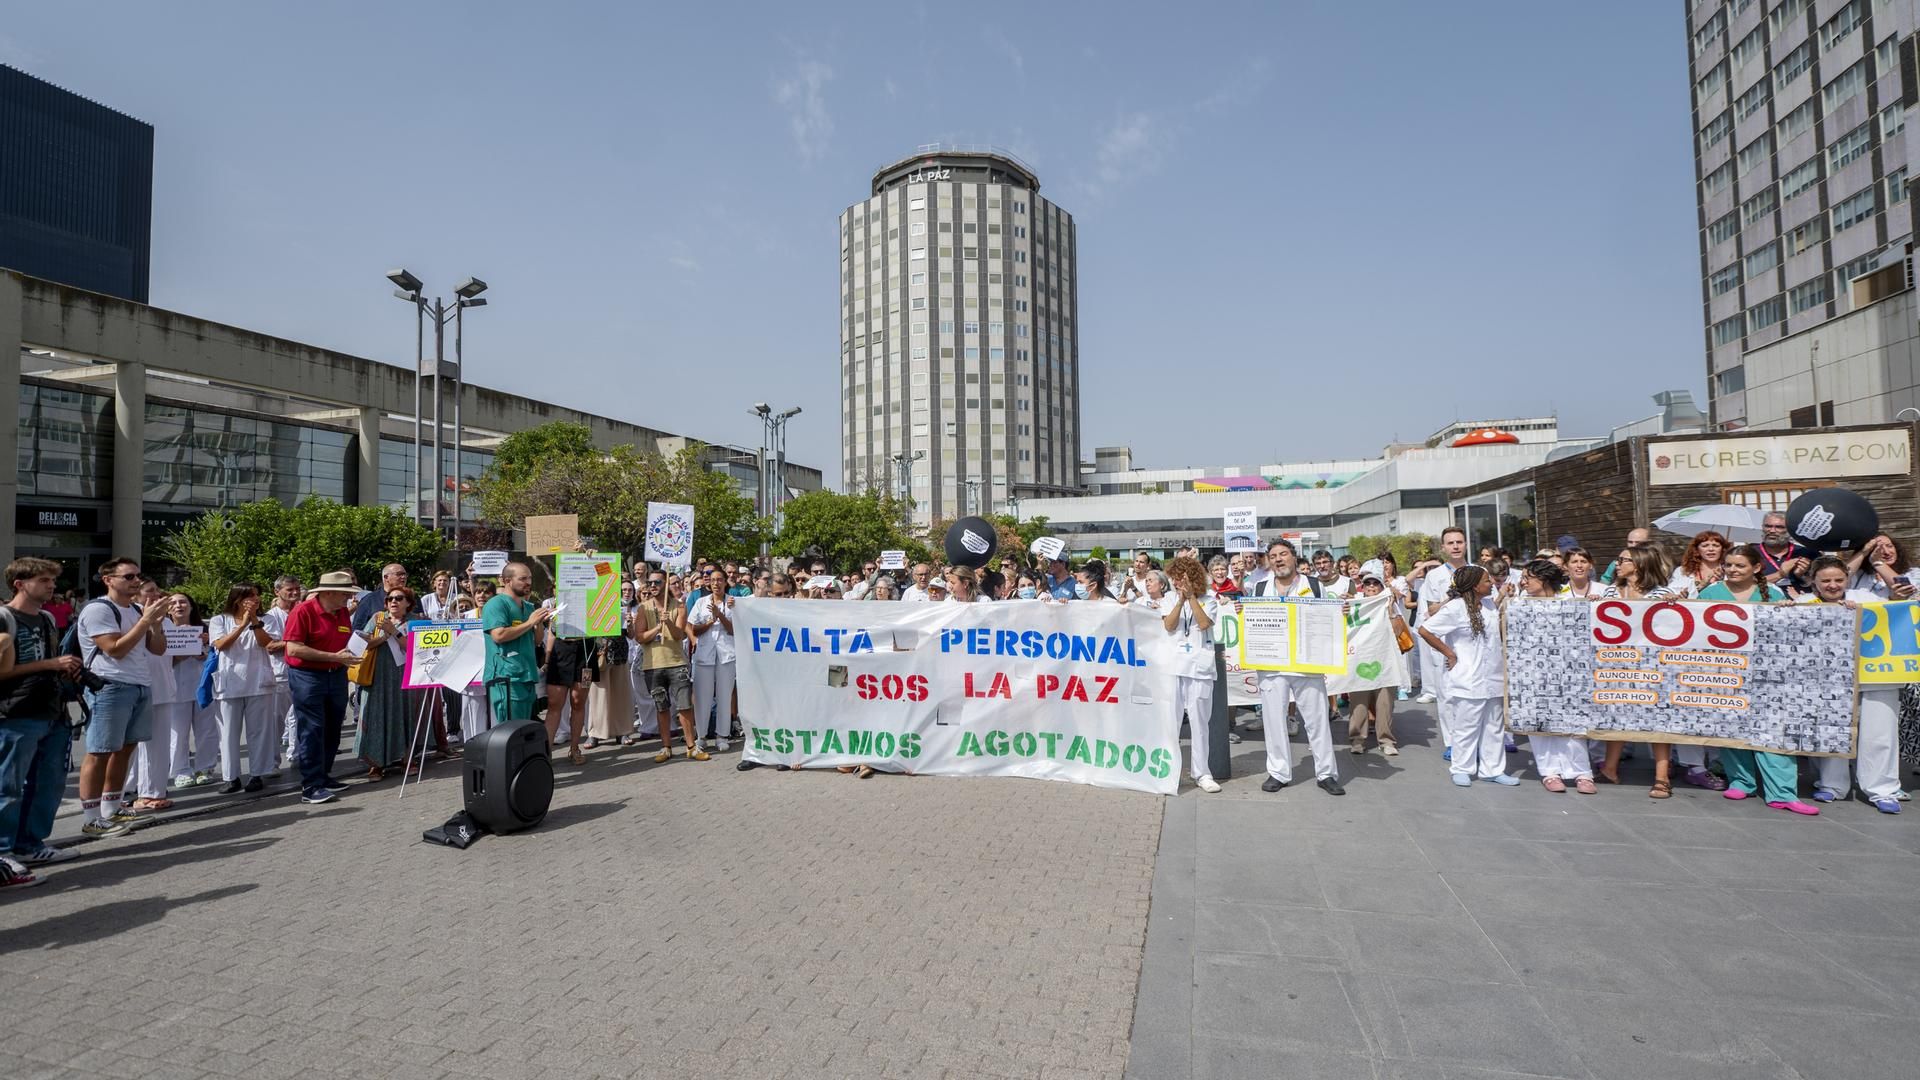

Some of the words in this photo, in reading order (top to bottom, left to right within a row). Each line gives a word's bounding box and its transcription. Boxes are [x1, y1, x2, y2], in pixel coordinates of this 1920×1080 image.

[909, 173, 923, 184] LA
[928, 169, 950, 181] PAZ
[530, 529, 574, 540] BAJO
[1159, 536, 1200, 548] Hospital
[1592, 601, 1750, 650] SOS
[422, 632, 449, 644] 620
[752, 628, 873, 654] FALTA
[940, 628, 1146, 667] PERSONAL
[1665, 653, 1712, 663] MUCHAS
[1864, 662, 1894, 672] en
[1598, 672, 1640, 680] AUNQUE
[1682, 674, 1738, 685] PODAMOS
[964, 672, 1012, 699] LA
[1036, 674, 1119, 704] PAZ
[1705, 697, 1744, 707] TODAS
[752, 727, 922, 759] ESTAMOS
[958, 731, 1172, 779] AGOTADOS
